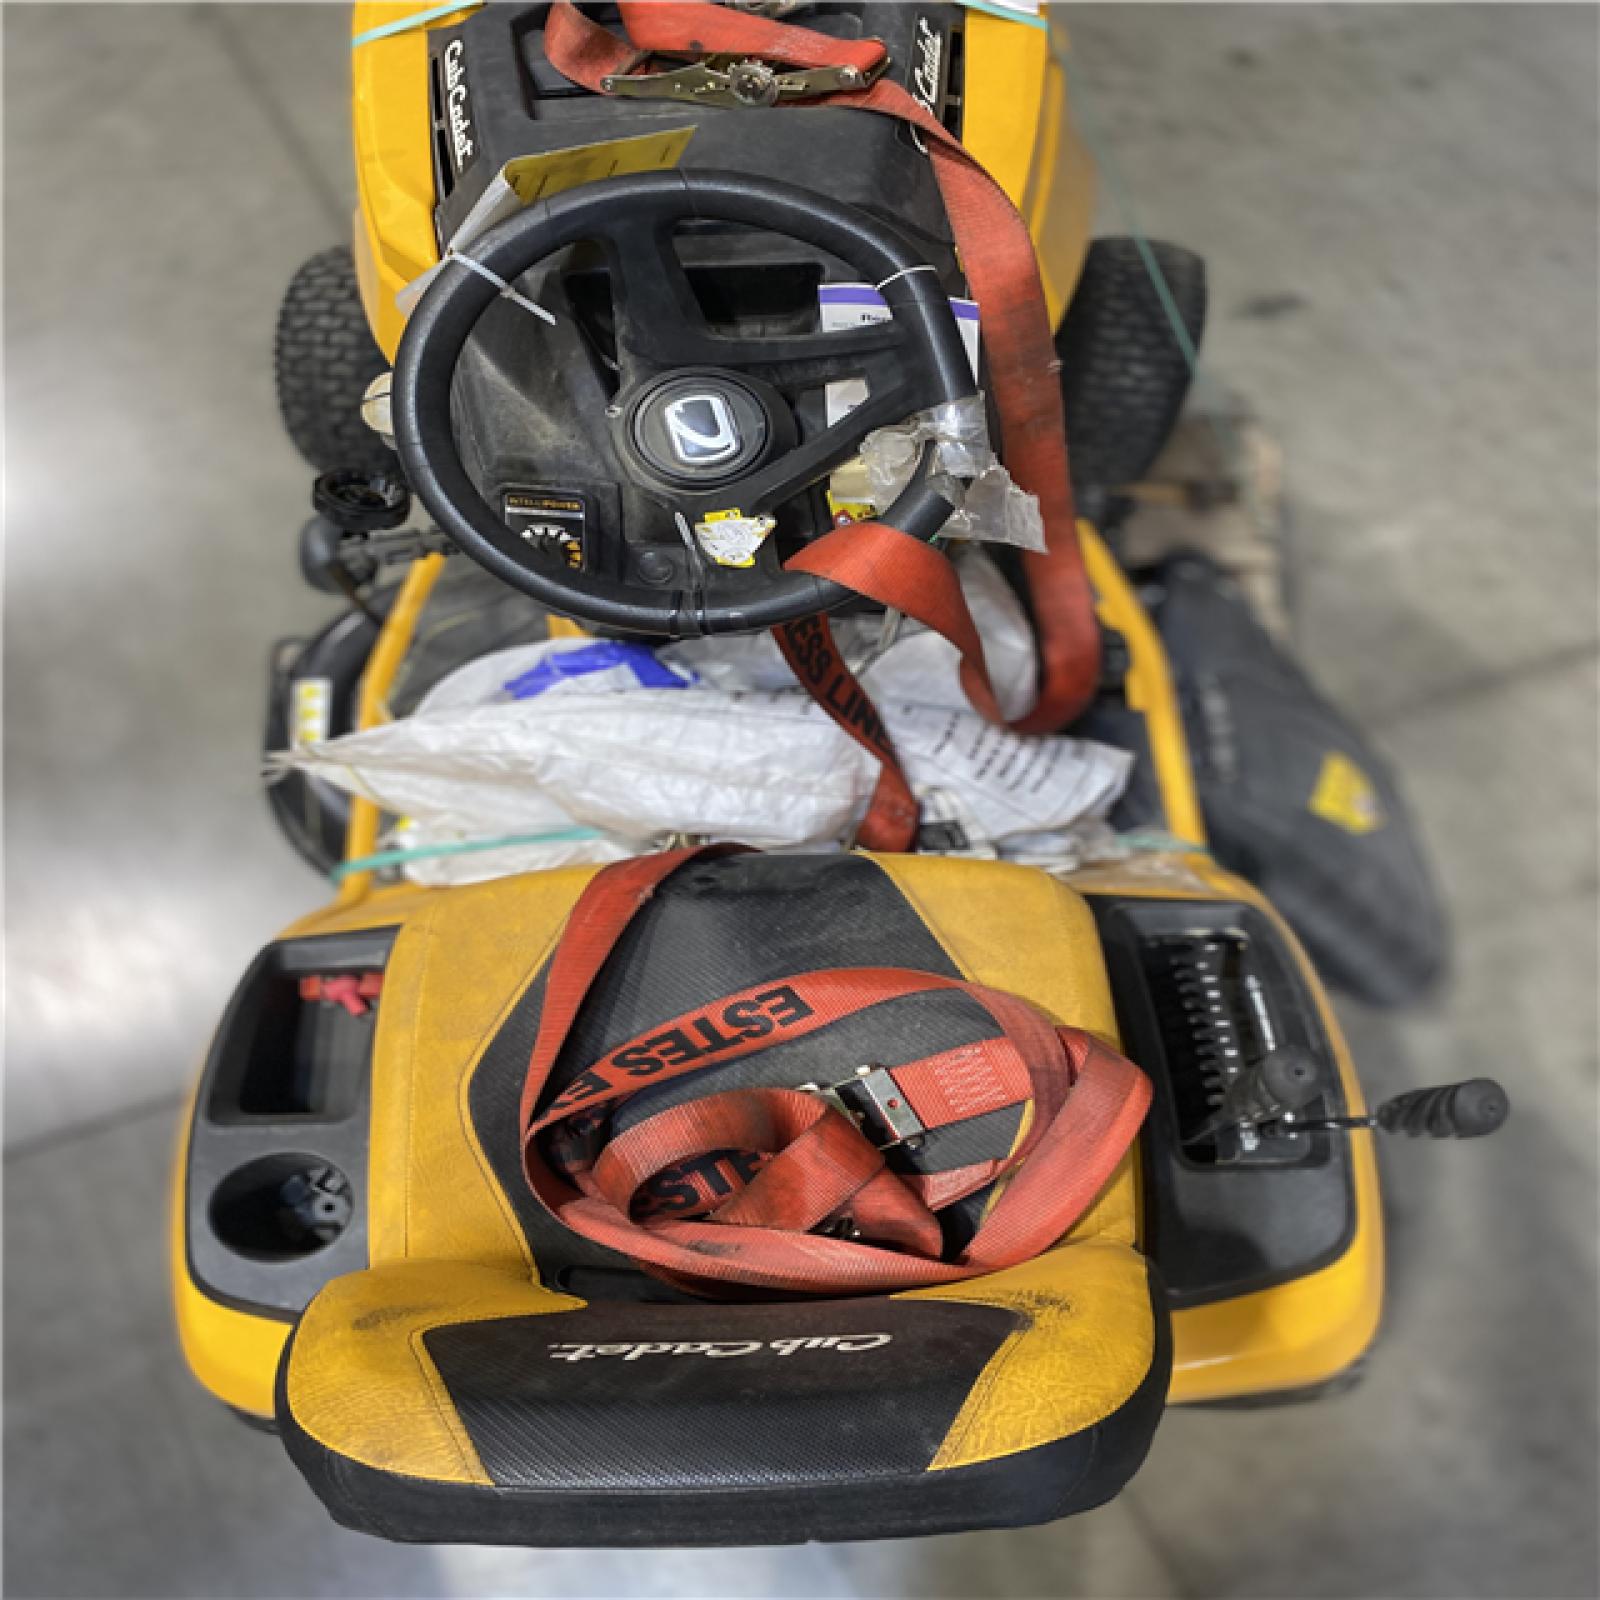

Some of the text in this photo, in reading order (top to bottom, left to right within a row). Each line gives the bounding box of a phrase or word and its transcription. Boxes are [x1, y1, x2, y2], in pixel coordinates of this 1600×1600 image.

[444, 39, 473, 169] Cub Cadet
[612, 985, 815, 1076] ESTES
[650, 1147, 764, 1211] STE
[770, 1334, 893, 1356] Cub
